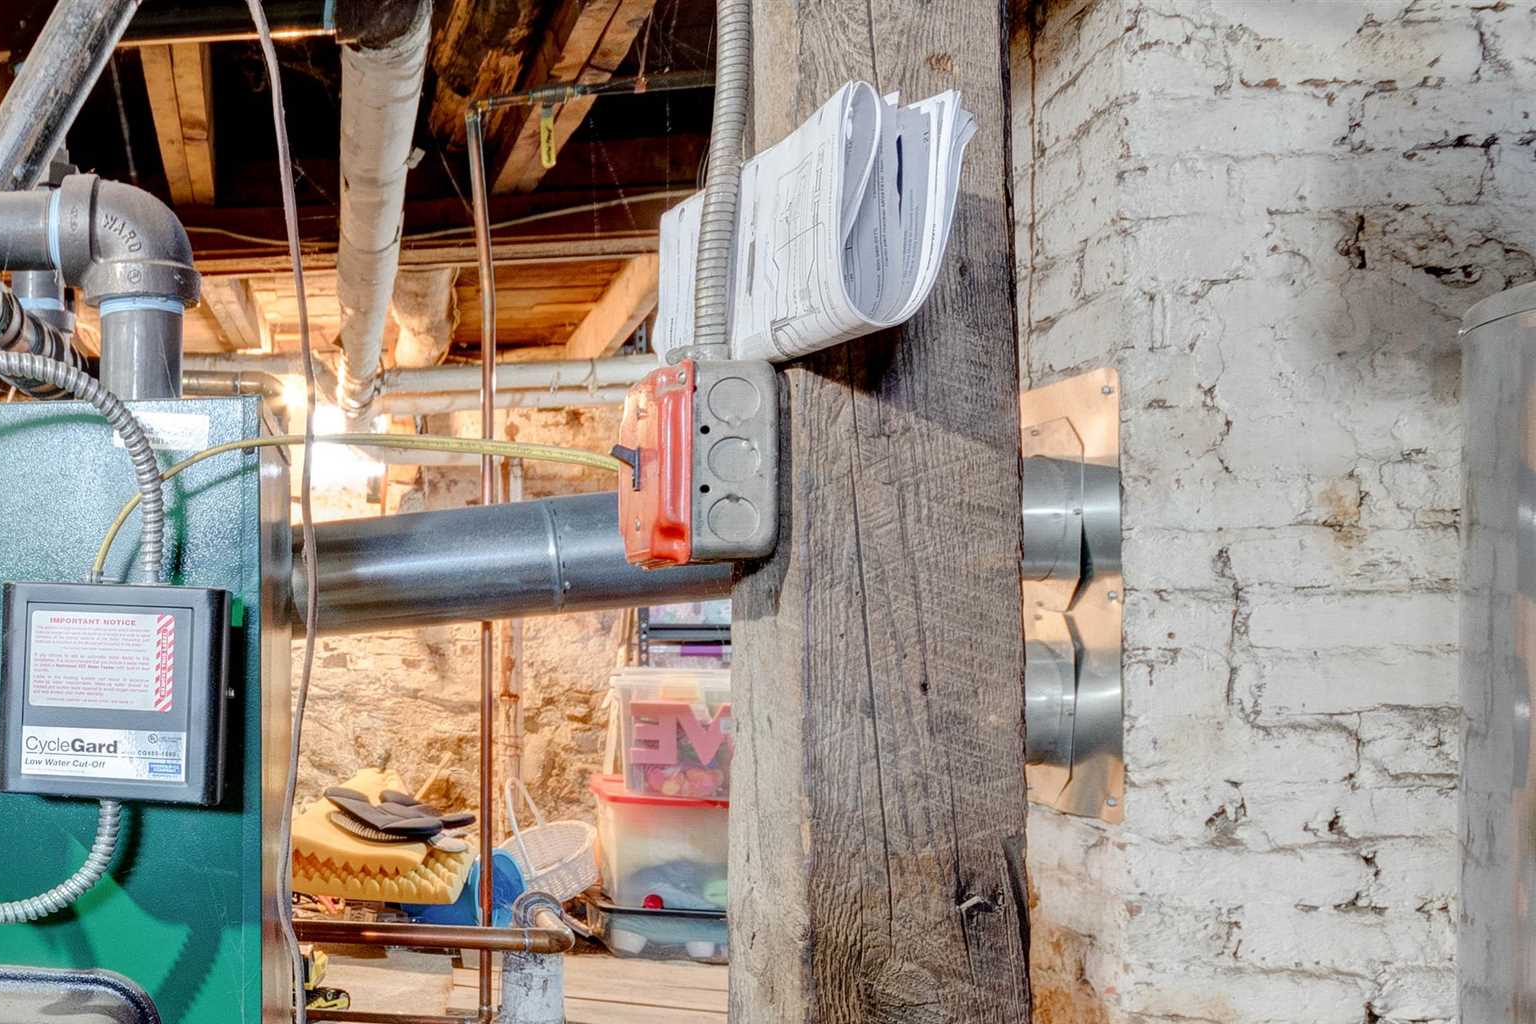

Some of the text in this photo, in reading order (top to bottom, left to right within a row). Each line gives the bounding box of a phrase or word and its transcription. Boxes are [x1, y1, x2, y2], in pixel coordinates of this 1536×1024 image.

[102, 213, 143, 253] WARD
[49, 616, 137, 627] IMPORTANT NOTICE
[25, 735, 119, 754] CycleGard
[24, 758, 107, 769] Low Water Cut-Off
